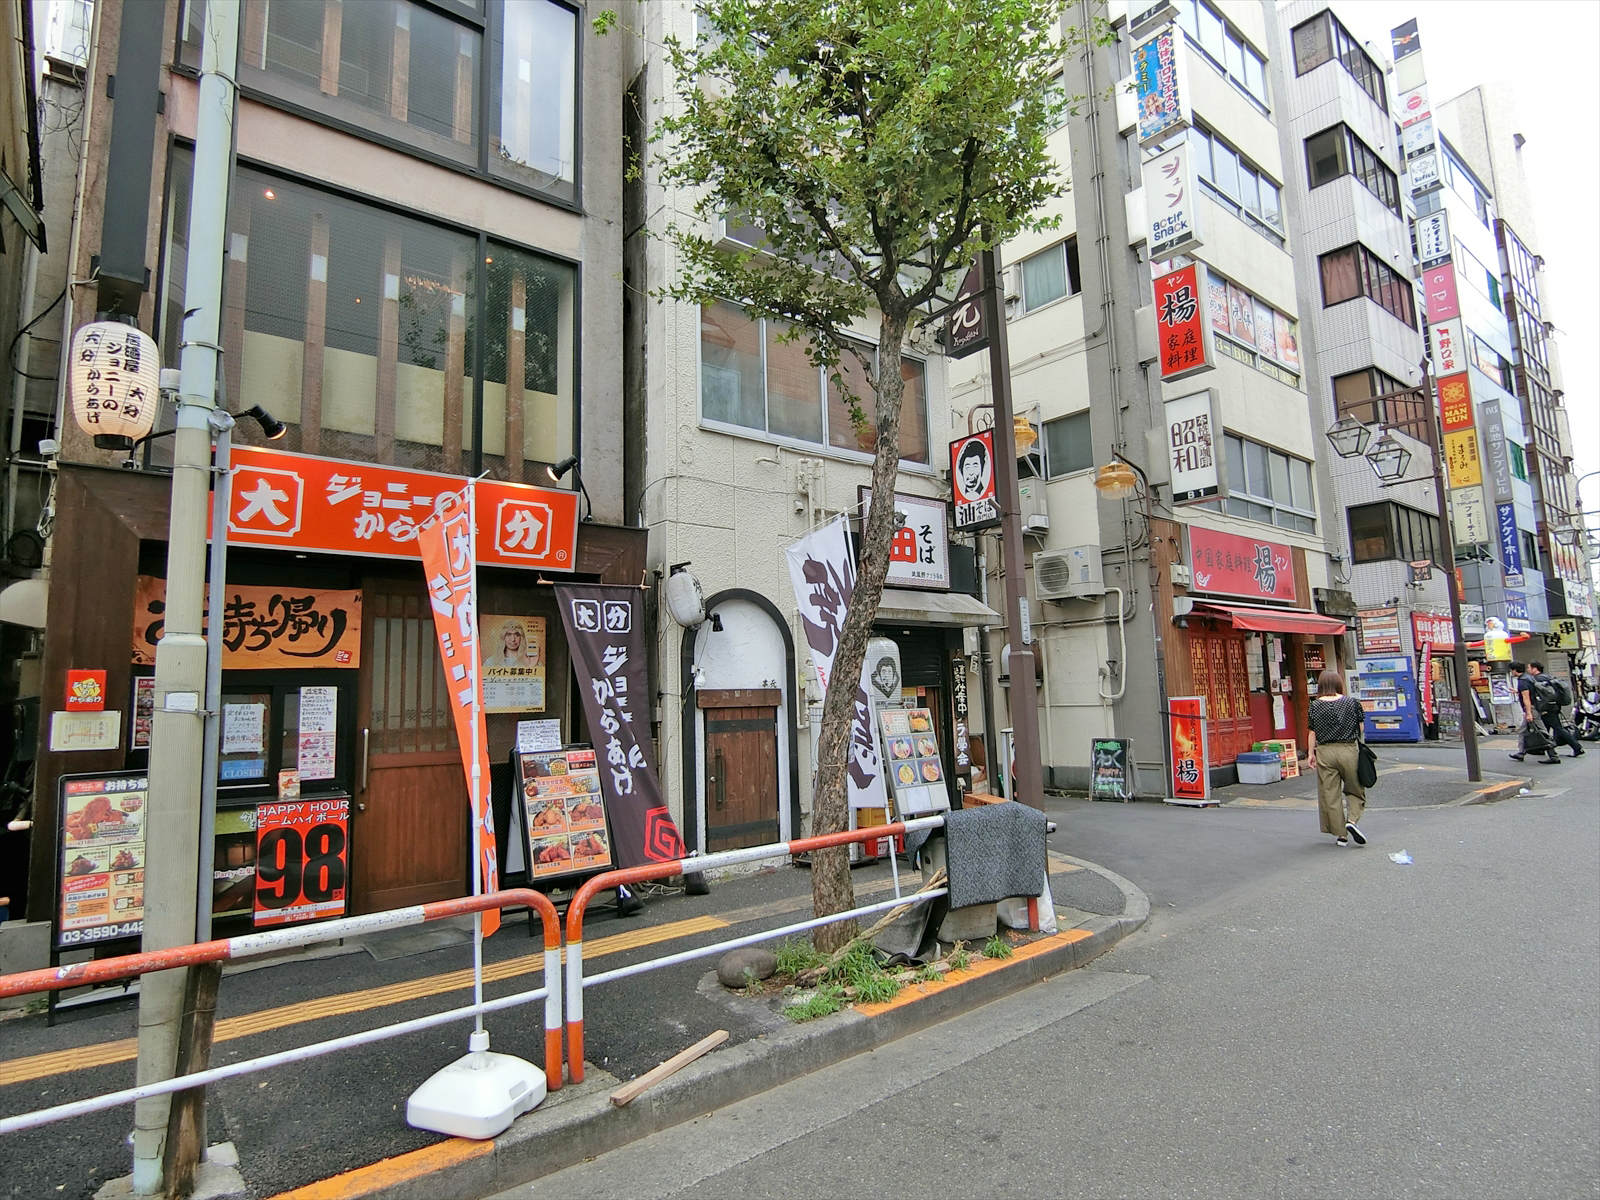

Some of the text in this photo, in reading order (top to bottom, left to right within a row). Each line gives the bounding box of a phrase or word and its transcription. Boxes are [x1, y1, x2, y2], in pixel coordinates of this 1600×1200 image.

[1143, 6, 1157, 20] 4F
[1154, 219, 1188, 241] snack
[1165, 238, 1179, 250] 2F
[1166, 274, 1185, 288] ヤン
[1159, 286, 1198, 327] 楊
[80, 330, 102, 364] 大分
[125, 332, 142, 375] 居酒屋
[1167, 329, 1197, 351] 家庭
[1439, 338, 1455, 371] 野口家
[1167, 348, 1198, 368] 料理
[102, 341, 120, 411] ジョニーの
[86, 369, 101, 424] からあげ
[121, 384, 146, 421] 大分
[1444, 406, 1467, 418] MAN
[1446, 413, 1468, 425] SUN
[1171, 418, 1199, 473] 昭和
[1488, 424, 1509, 495] 西池サンケイビル
[236, 477, 291, 527] 大
[1187, 489, 1205, 499] B1
[504, 509, 544, 550] 分
[959, 504, 975, 525] 油
[918, 524, 936, 565] そば
[1499, 506, 1519, 575] サンケイホーム
[1195, 546, 1252, 573] 中国家庭料理
[1253, 543, 1277, 594] 楊
[1274, 553, 1289, 572] ヤン
[592, 678, 634, 796] からあげ
[224, 769, 262, 778] CLOSED
[1176, 758, 1199, 784] 楊
[257, 800, 350, 817] HAPPY HOUR
[257, 814, 350, 828] ビームハイボール
[257, 823, 346, 910] 98
